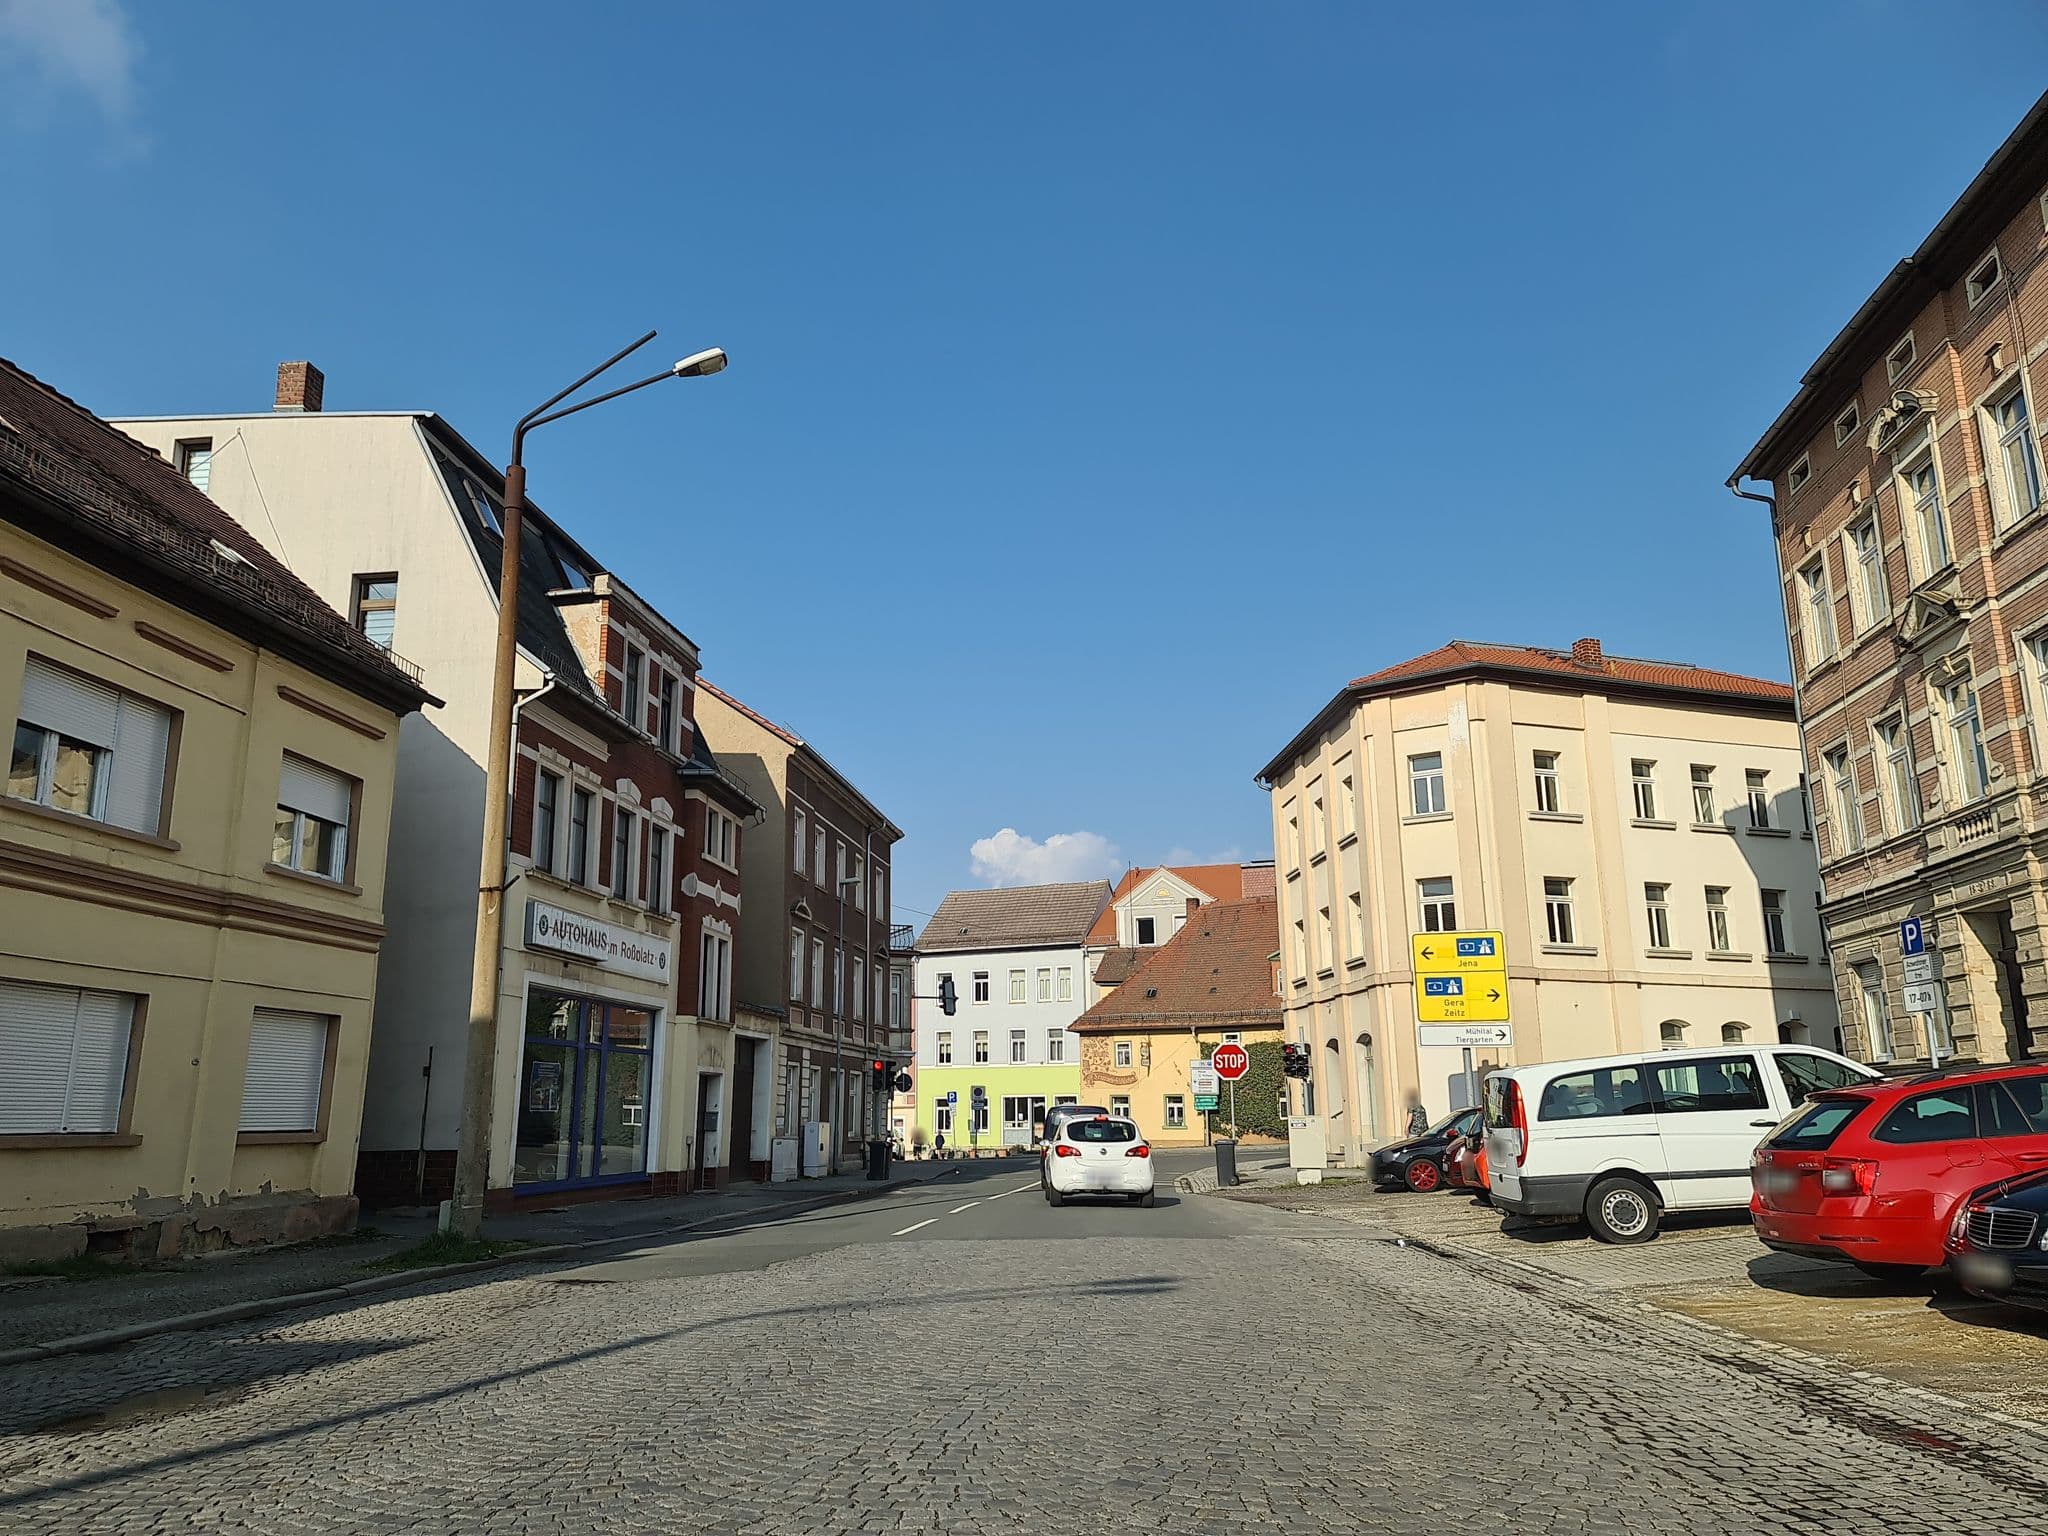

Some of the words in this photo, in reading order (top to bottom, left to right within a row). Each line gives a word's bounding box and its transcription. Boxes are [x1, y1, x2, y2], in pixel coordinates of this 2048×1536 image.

[551, 919, 608, 950] AUTOHAUS
[1905, 923, 1918, 951] P
[1458, 960, 1478, 968] Jena
[1444, 999, 1465, 1007] Gera
[1444, 1009, 1466, 1017] Zeitz
[1456, 1036, 1494, 1045] Tiergarten
[1215, 1054, 1245, 1069] STOP
